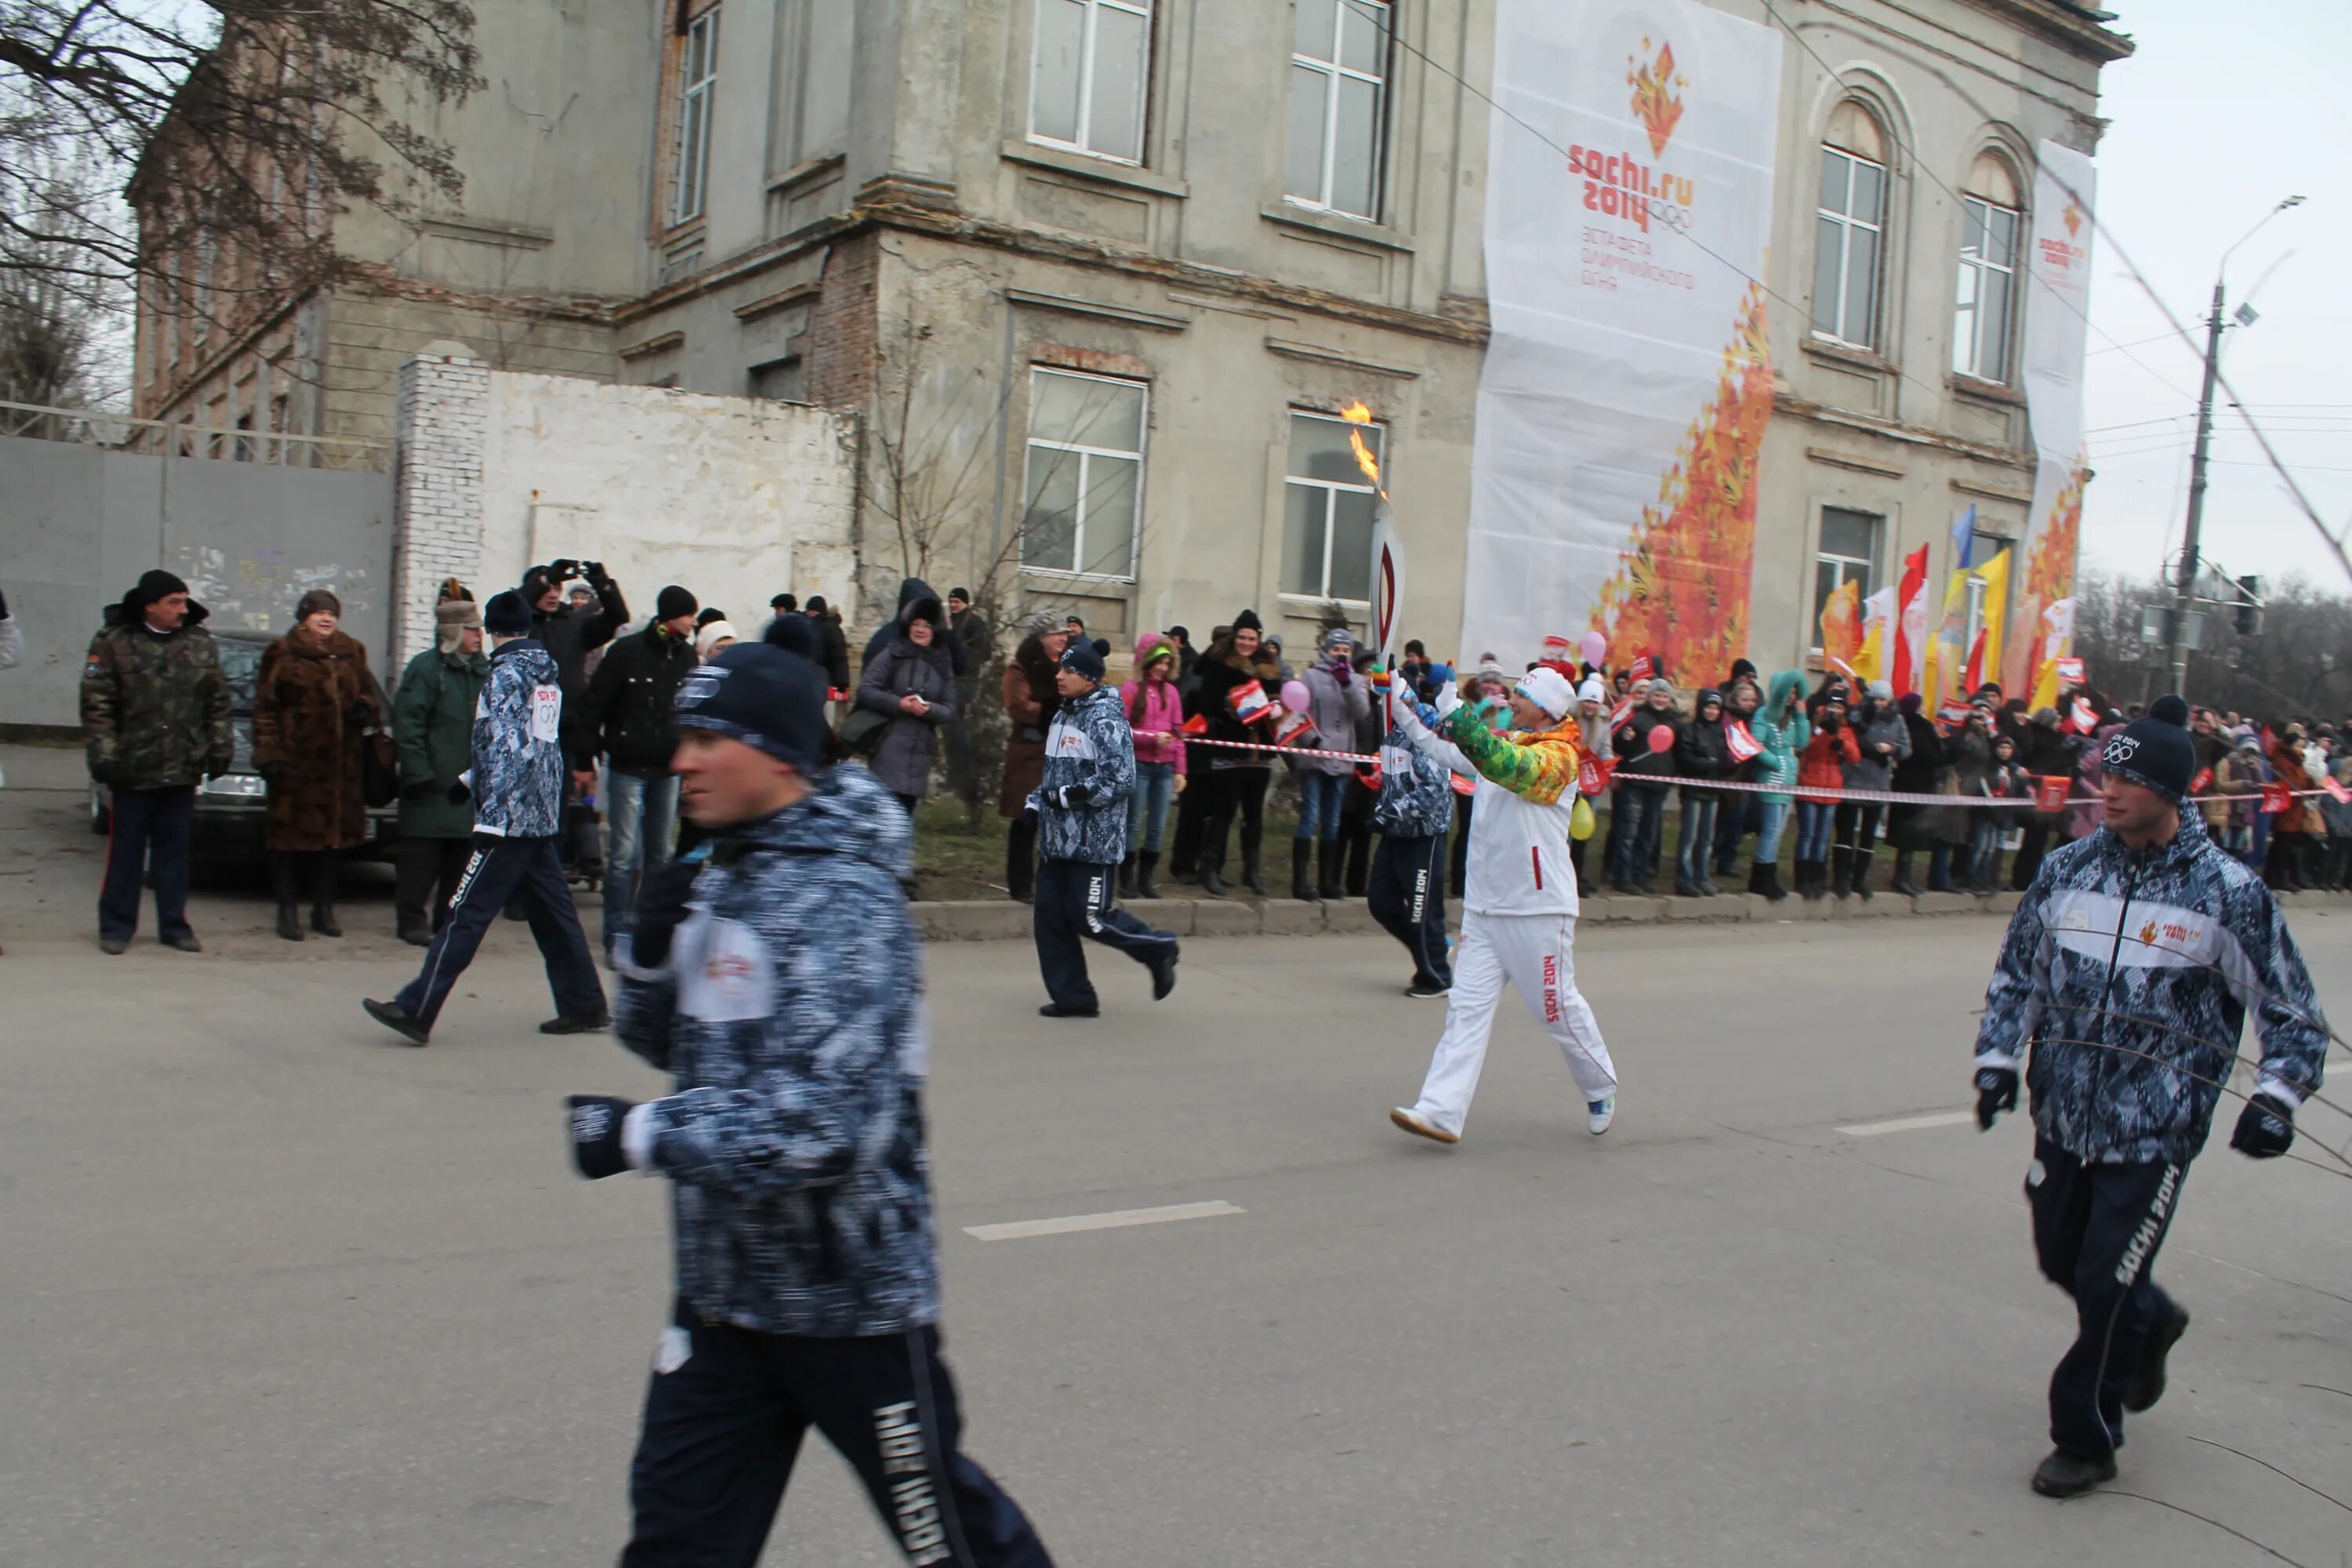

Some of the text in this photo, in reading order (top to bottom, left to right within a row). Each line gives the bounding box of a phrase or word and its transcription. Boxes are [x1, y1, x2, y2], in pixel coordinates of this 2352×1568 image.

[1568, 144, 1693, 206] sochi.ru
[1583, 180, 1650, 234] 2014
[2122, 735, 2140, 749] 2014
[1415, 869, 1428, 893] 2014
[1544, 955, 1559, 1023] SOCHI 2014
[2114, 1163, 2180, 1287] SOCHI 2014
